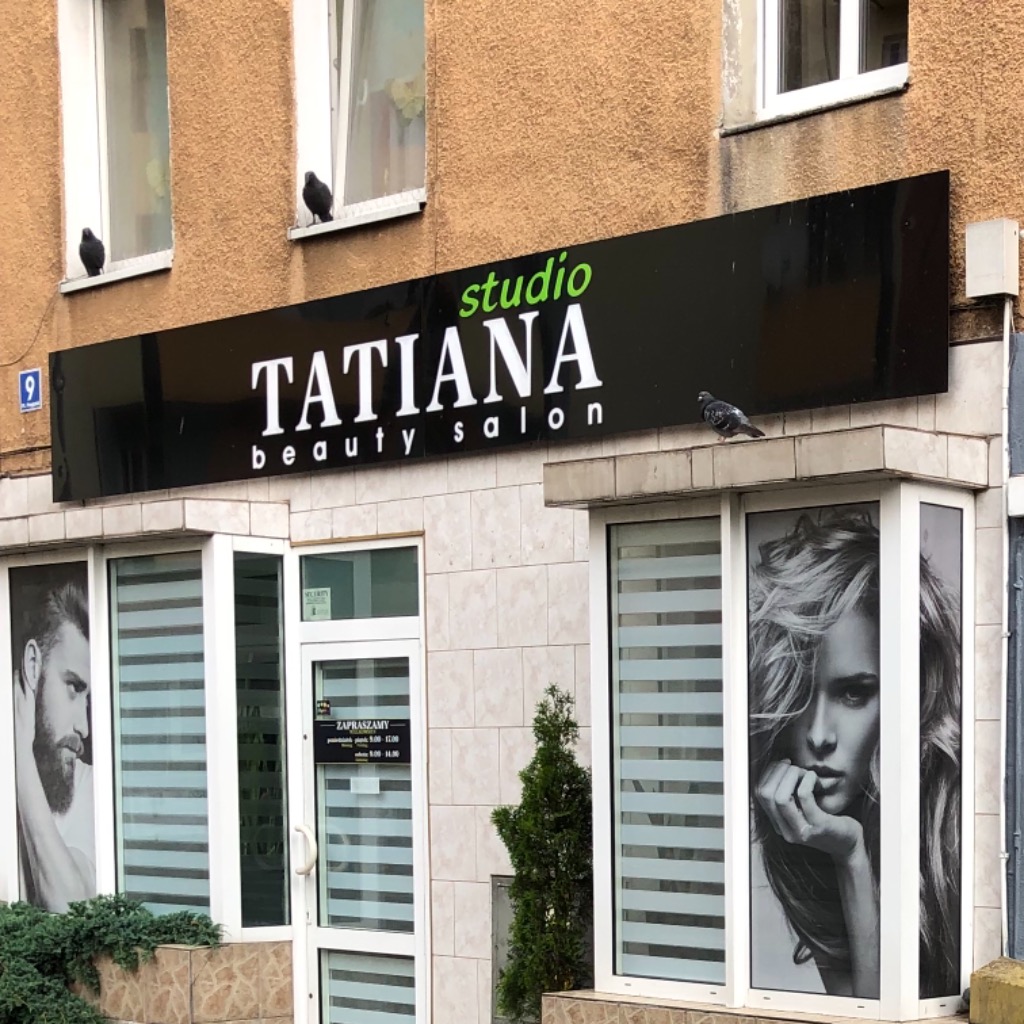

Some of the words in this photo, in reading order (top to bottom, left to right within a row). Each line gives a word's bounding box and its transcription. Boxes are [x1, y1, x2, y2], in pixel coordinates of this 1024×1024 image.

[459, 251, 592, 318] studio
[25, 375, 35, 402] 9
[252, 303, 603, 437] TATIANA
[252, 426, 416, 470] beauty
[454, 402, 603, 443] salon
[336, 720, 390, 730] ZAPRASZAMY
